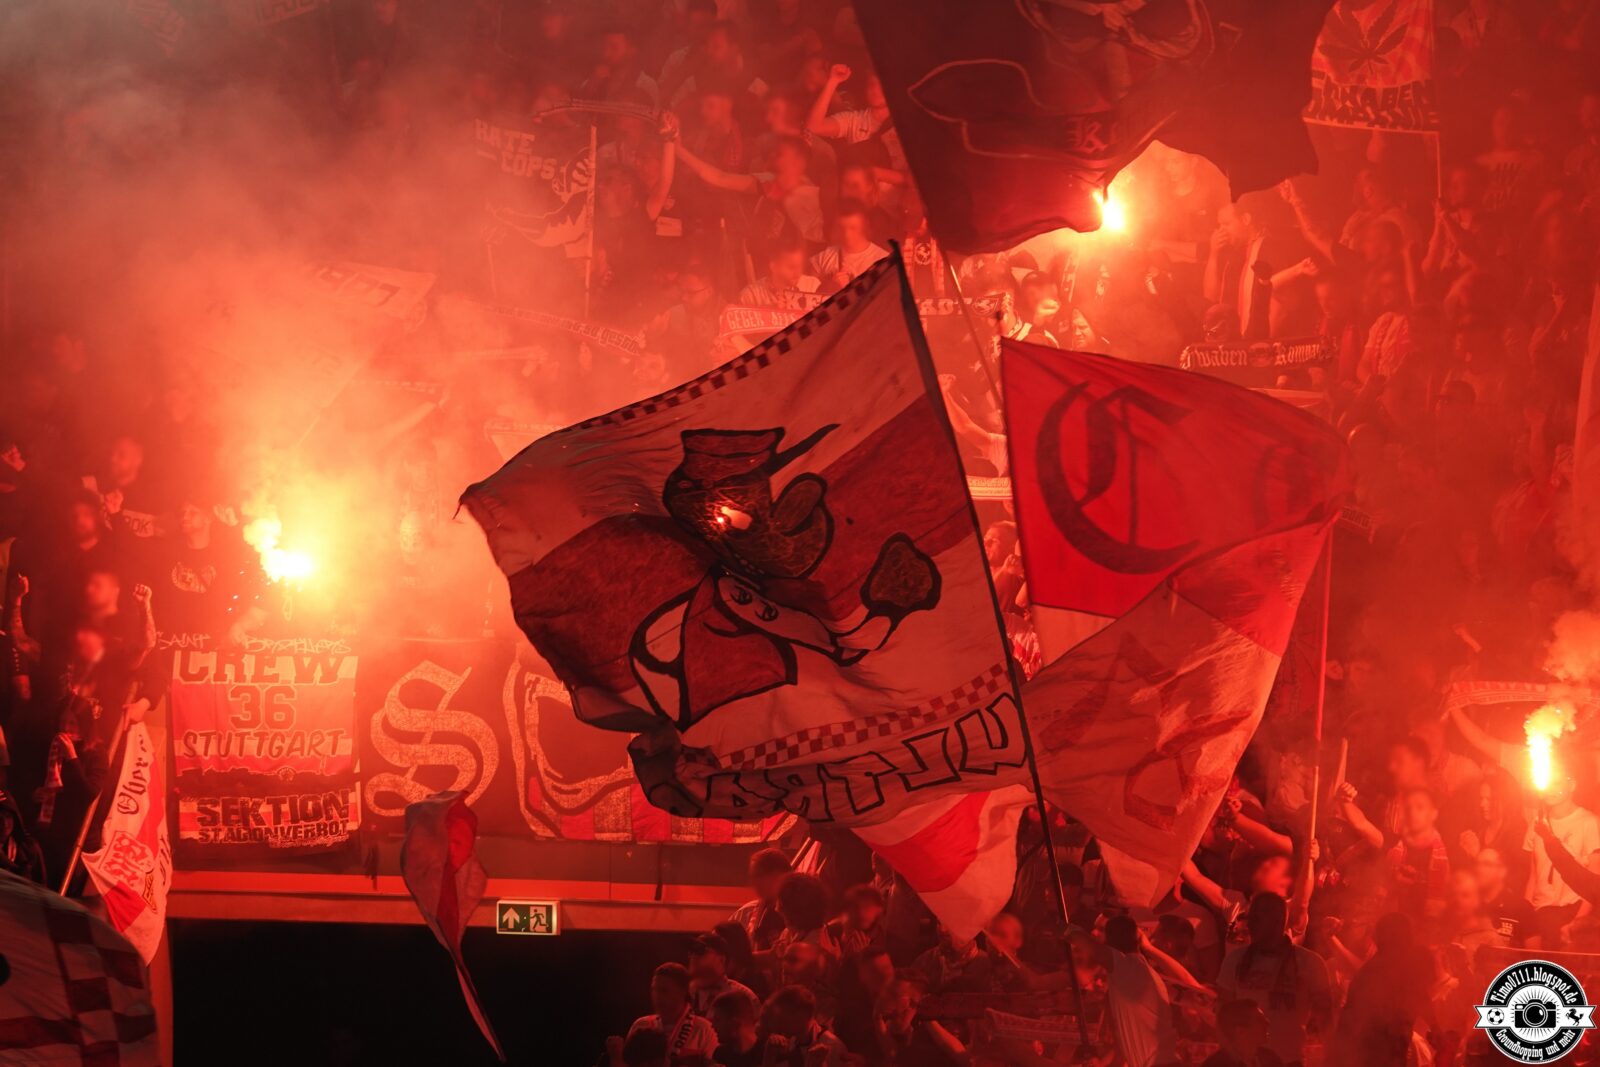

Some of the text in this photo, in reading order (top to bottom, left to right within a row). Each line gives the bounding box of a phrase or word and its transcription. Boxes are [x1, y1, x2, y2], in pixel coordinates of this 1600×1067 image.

[475, 118, 535, 154] HATE
[501, 150, 557, 179] COPS
[178, 650, 345, 686] CREW
[229, 684, 297, 730] 36
[183, 728, 346, 758] STUTTGART
[197, 789, 351, 828] SEKTION
